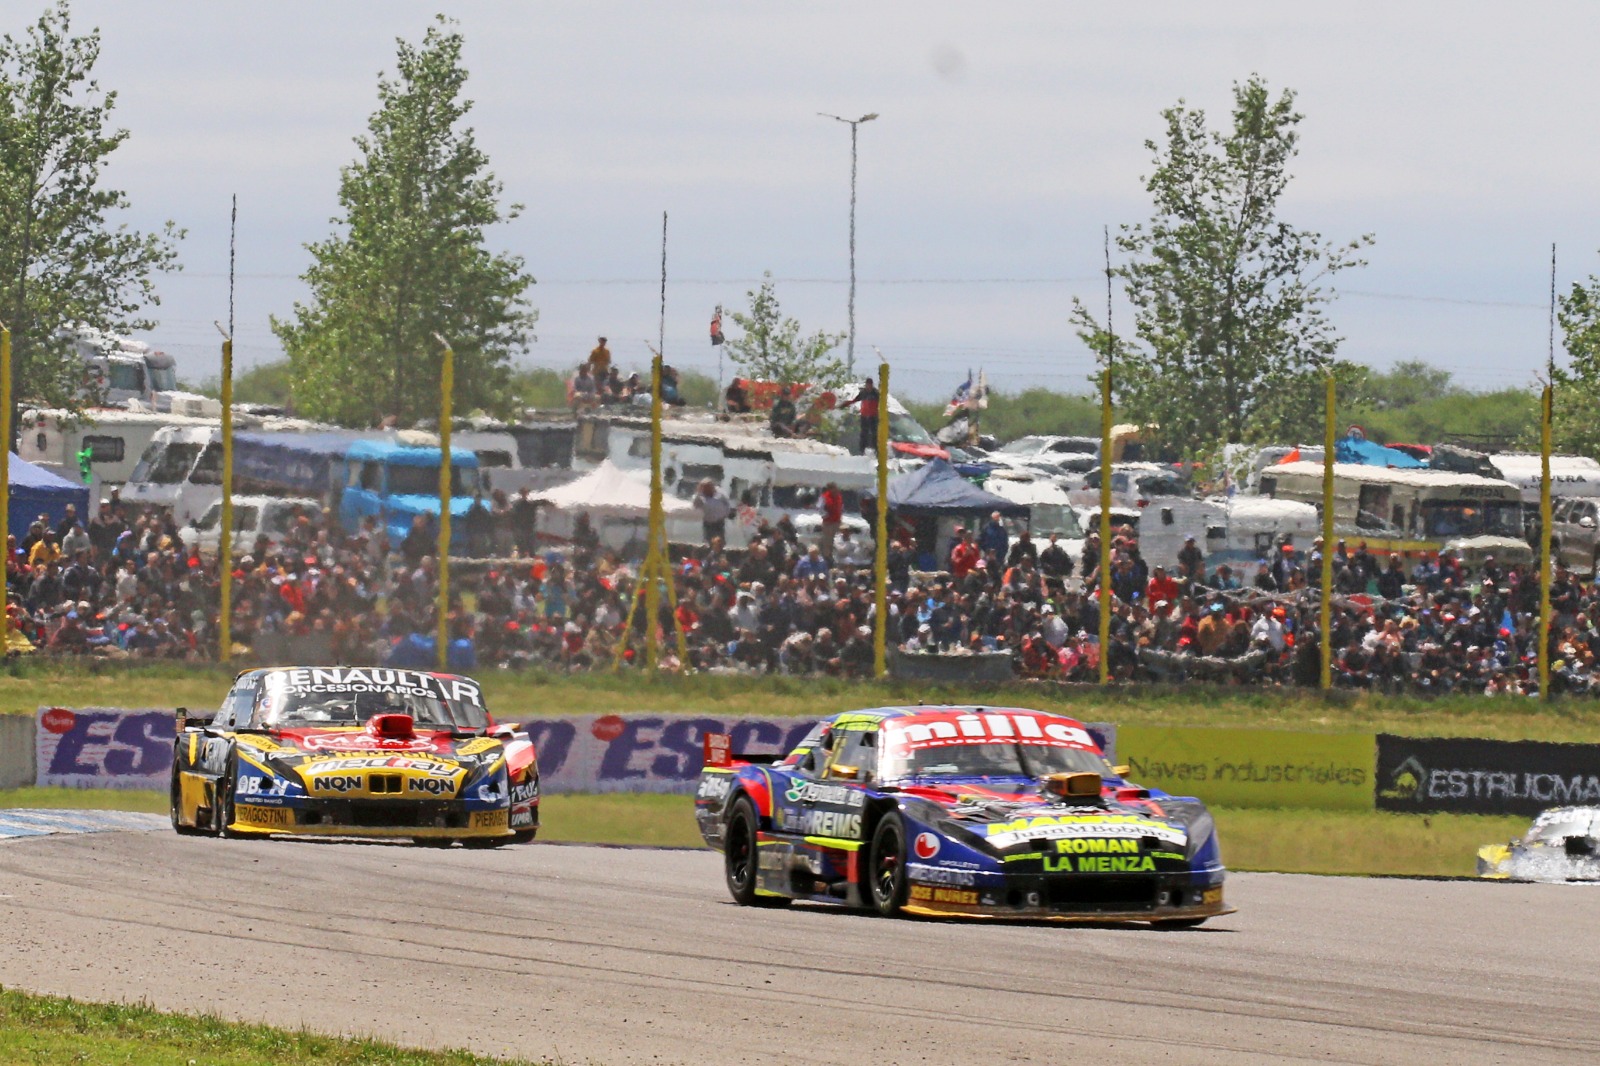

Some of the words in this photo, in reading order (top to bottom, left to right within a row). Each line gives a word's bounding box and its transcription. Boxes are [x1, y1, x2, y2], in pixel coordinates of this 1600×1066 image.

[264, 669, 436, 691] RENAULT
[898, 714, 1093, 746] milla
[248, 776, 289, 796] BN
[314, 776, 362, 792] NQN
[409, 778, 455, 794] NQN
[1056, 838, 1140, 854] ROMAN
[1043, 856, 1073, 872] LA
[1078, 856, 1157, 872] MENZA
